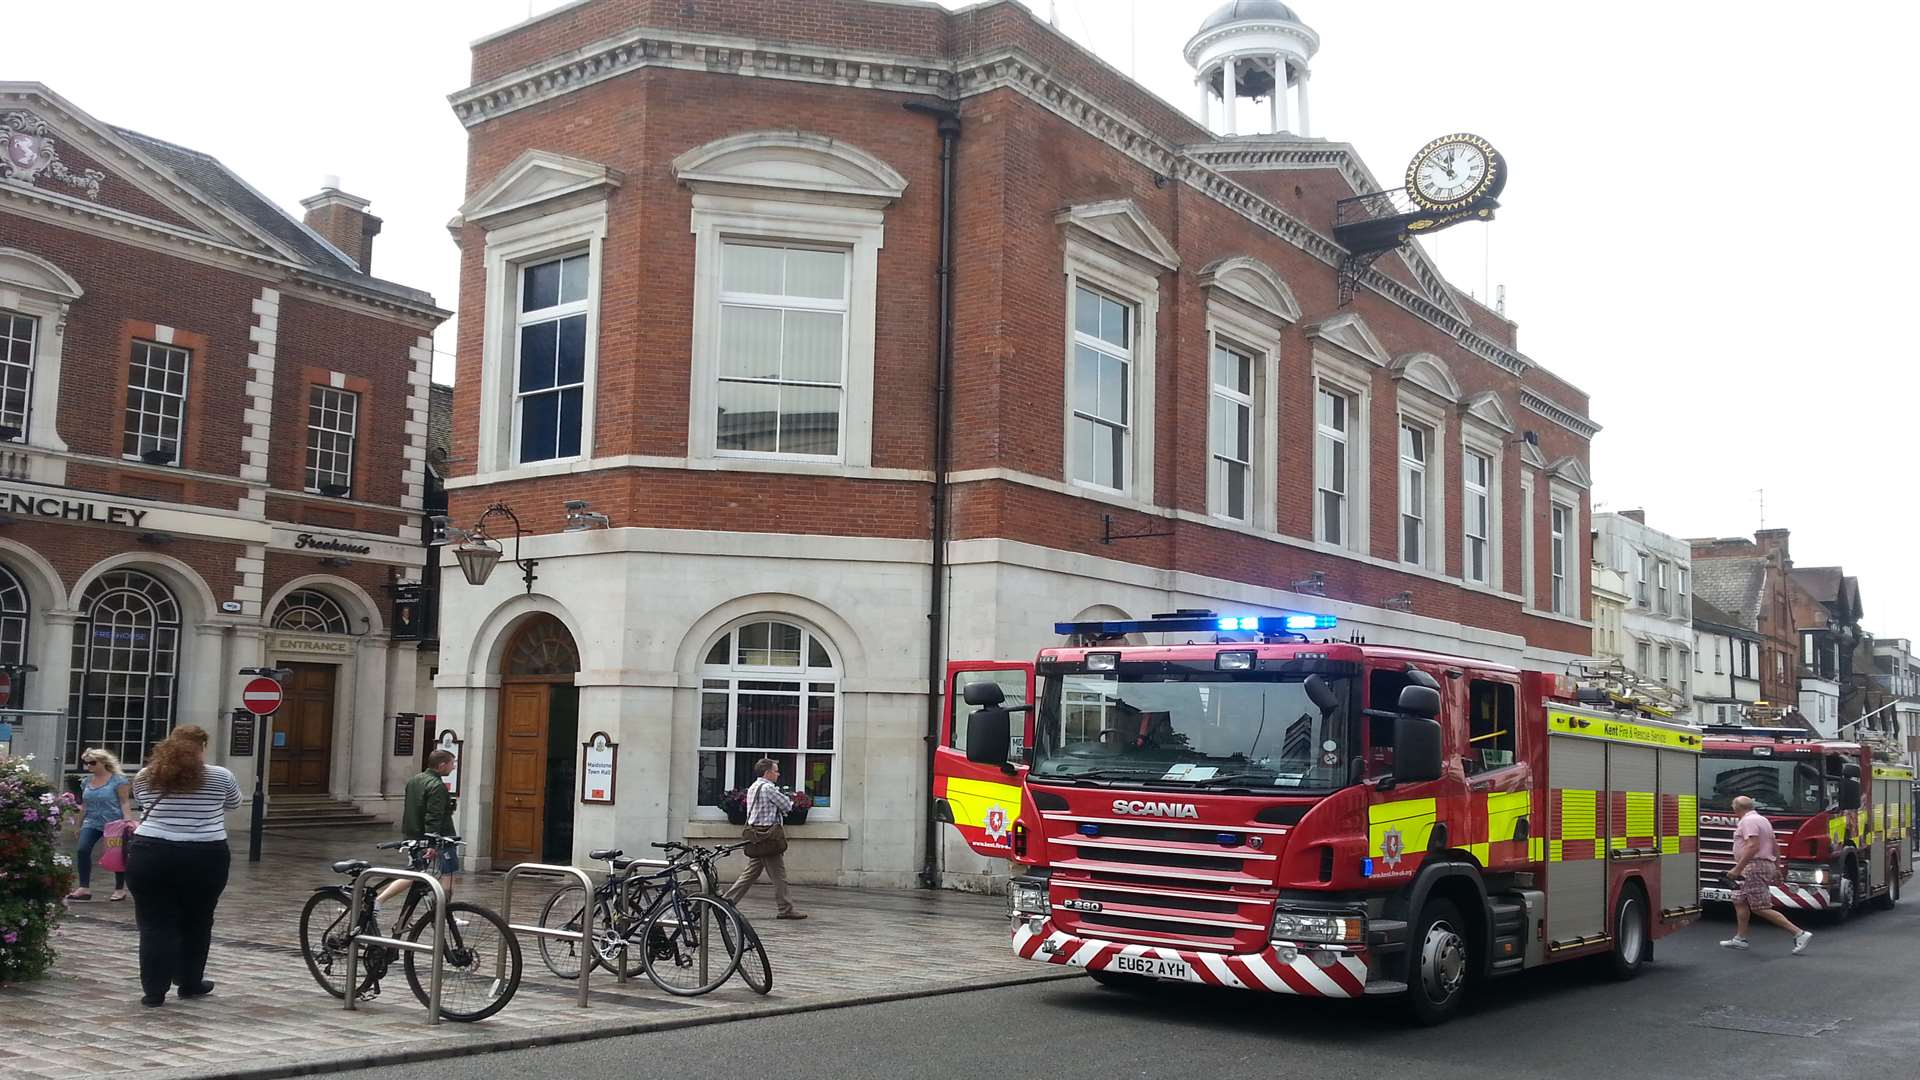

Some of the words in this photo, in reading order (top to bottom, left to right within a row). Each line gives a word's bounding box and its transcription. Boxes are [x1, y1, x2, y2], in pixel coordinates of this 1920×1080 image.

[294, 533, 371, 555] Freehouse
[280, 639, 346, 652] ENTRANCE
[1604, 722, 1618, 736] Kent
[1619, 724, 1629, 737] Fire
[1112, 799, 1199, 819] SCANIA
[1064, 899, 1073, 908] P
[1074, 901, 1100, 911] 280
[1118, 956, 1154, 973] EU62
[1158, 961, 1185, 977] AYH
